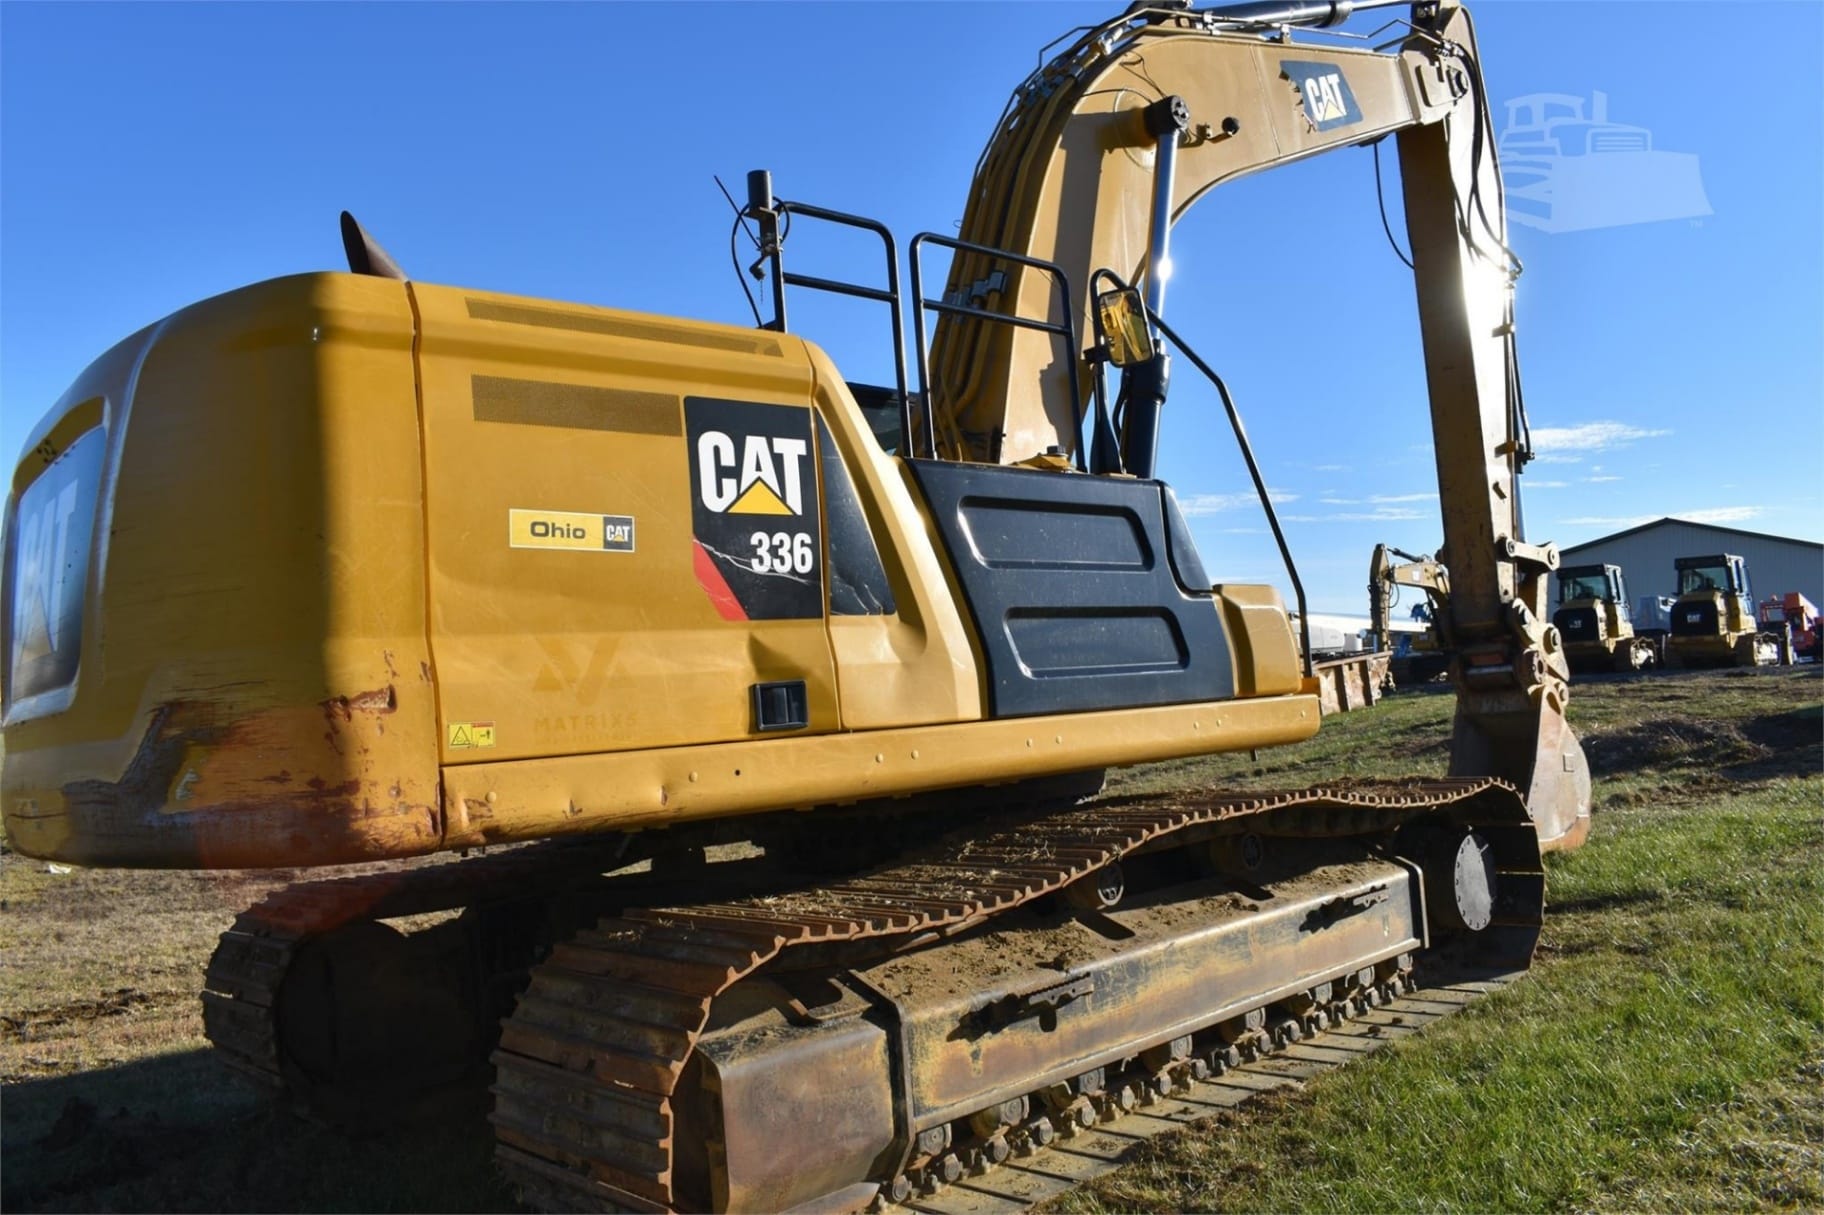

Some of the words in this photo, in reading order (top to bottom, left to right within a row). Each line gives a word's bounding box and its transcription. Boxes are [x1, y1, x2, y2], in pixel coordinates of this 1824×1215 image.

[1305, 74, 1347, 122] CAT
[698, 431, 807, 516] CAT
[530, 521, 586, 540] Ohio
[606, 524, 631, 543] CAT
[750, 531, 813, 574] 336
[14, 477, 79, 660] CAT
